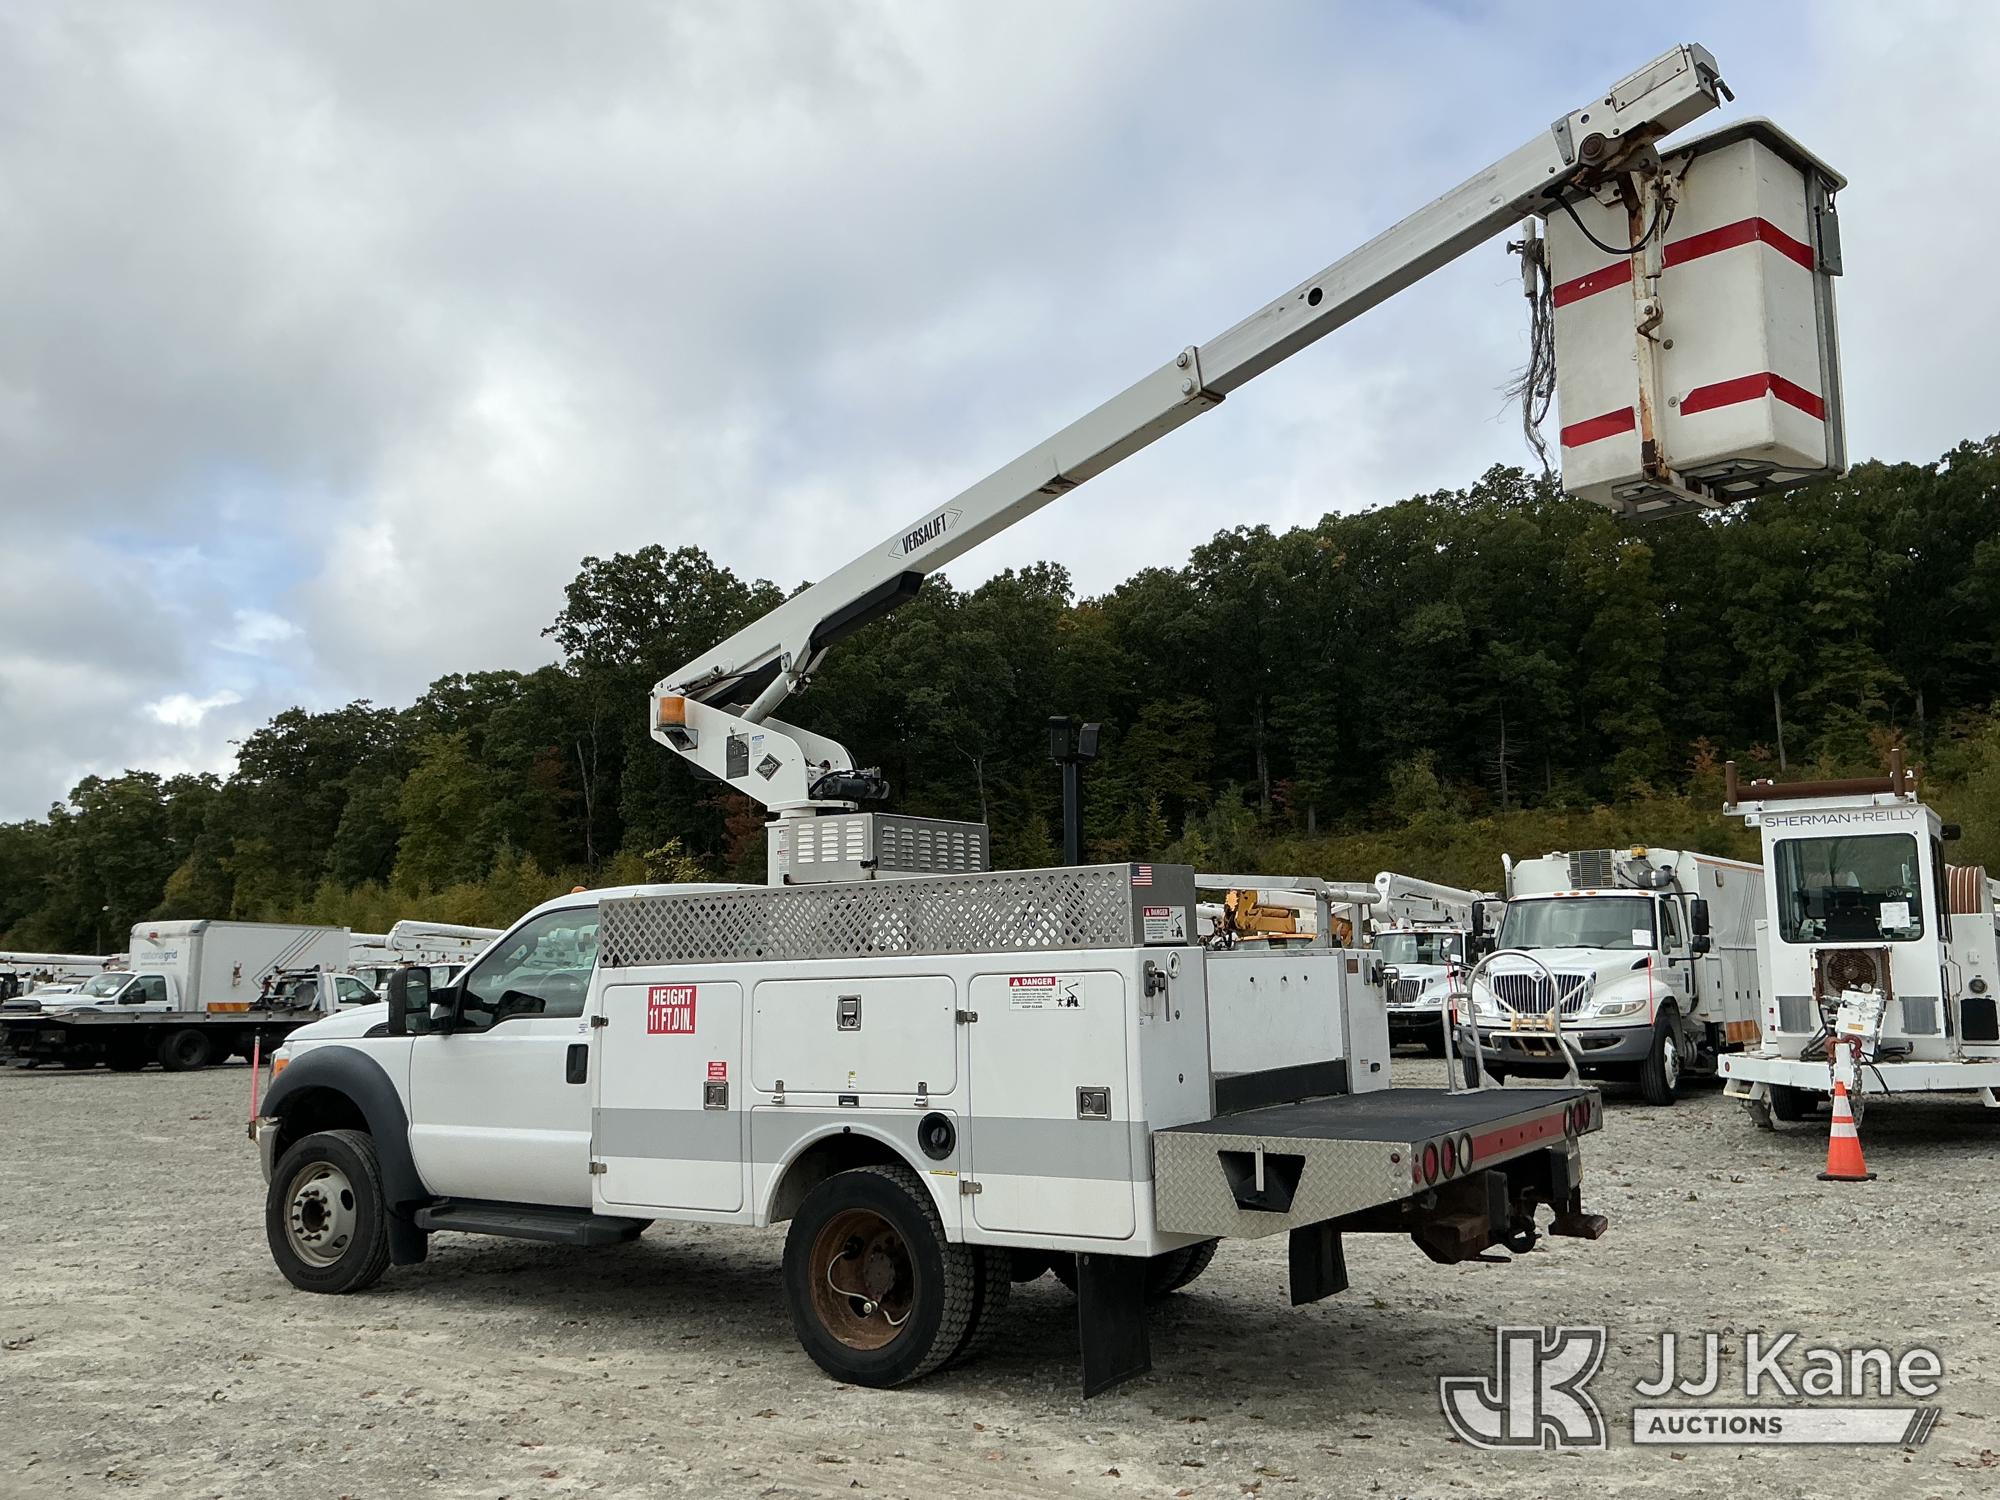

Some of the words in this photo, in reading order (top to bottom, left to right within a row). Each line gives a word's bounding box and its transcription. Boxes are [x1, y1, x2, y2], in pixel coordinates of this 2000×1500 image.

[902, 513, 946, 554] VERSALIFT
[1765, 809, 1919, 828] SHERMAN+REILLY
[652, 989, 692, 1006] HEIGHT
